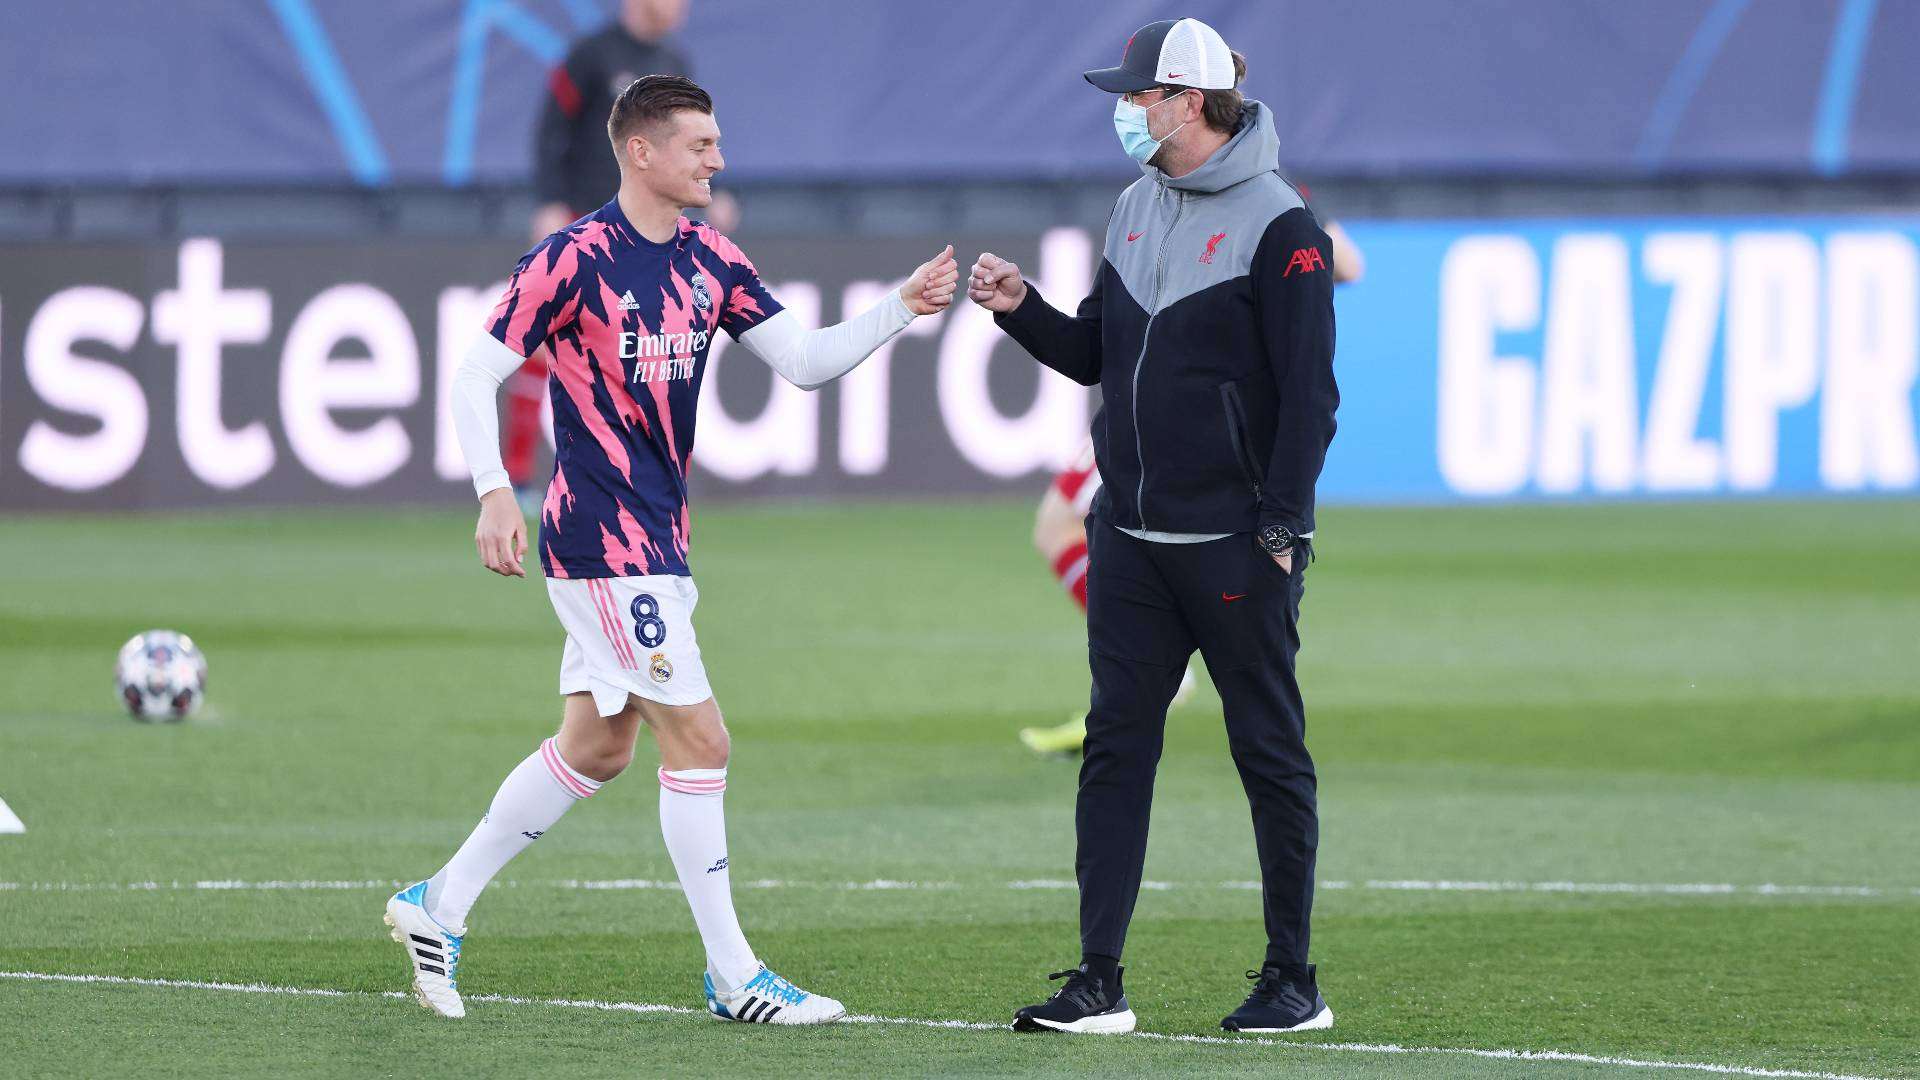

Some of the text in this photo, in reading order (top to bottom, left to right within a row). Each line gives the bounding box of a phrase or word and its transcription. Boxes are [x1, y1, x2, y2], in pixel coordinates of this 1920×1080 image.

[1282, 247, 1326, 278] AXA
[618, 328, 708, 359] Emirates
[18, 229, 1092, 490] sterard
[633, 357, 696, 384] FLY BETTER
[630, 593, 666, 648] 8
